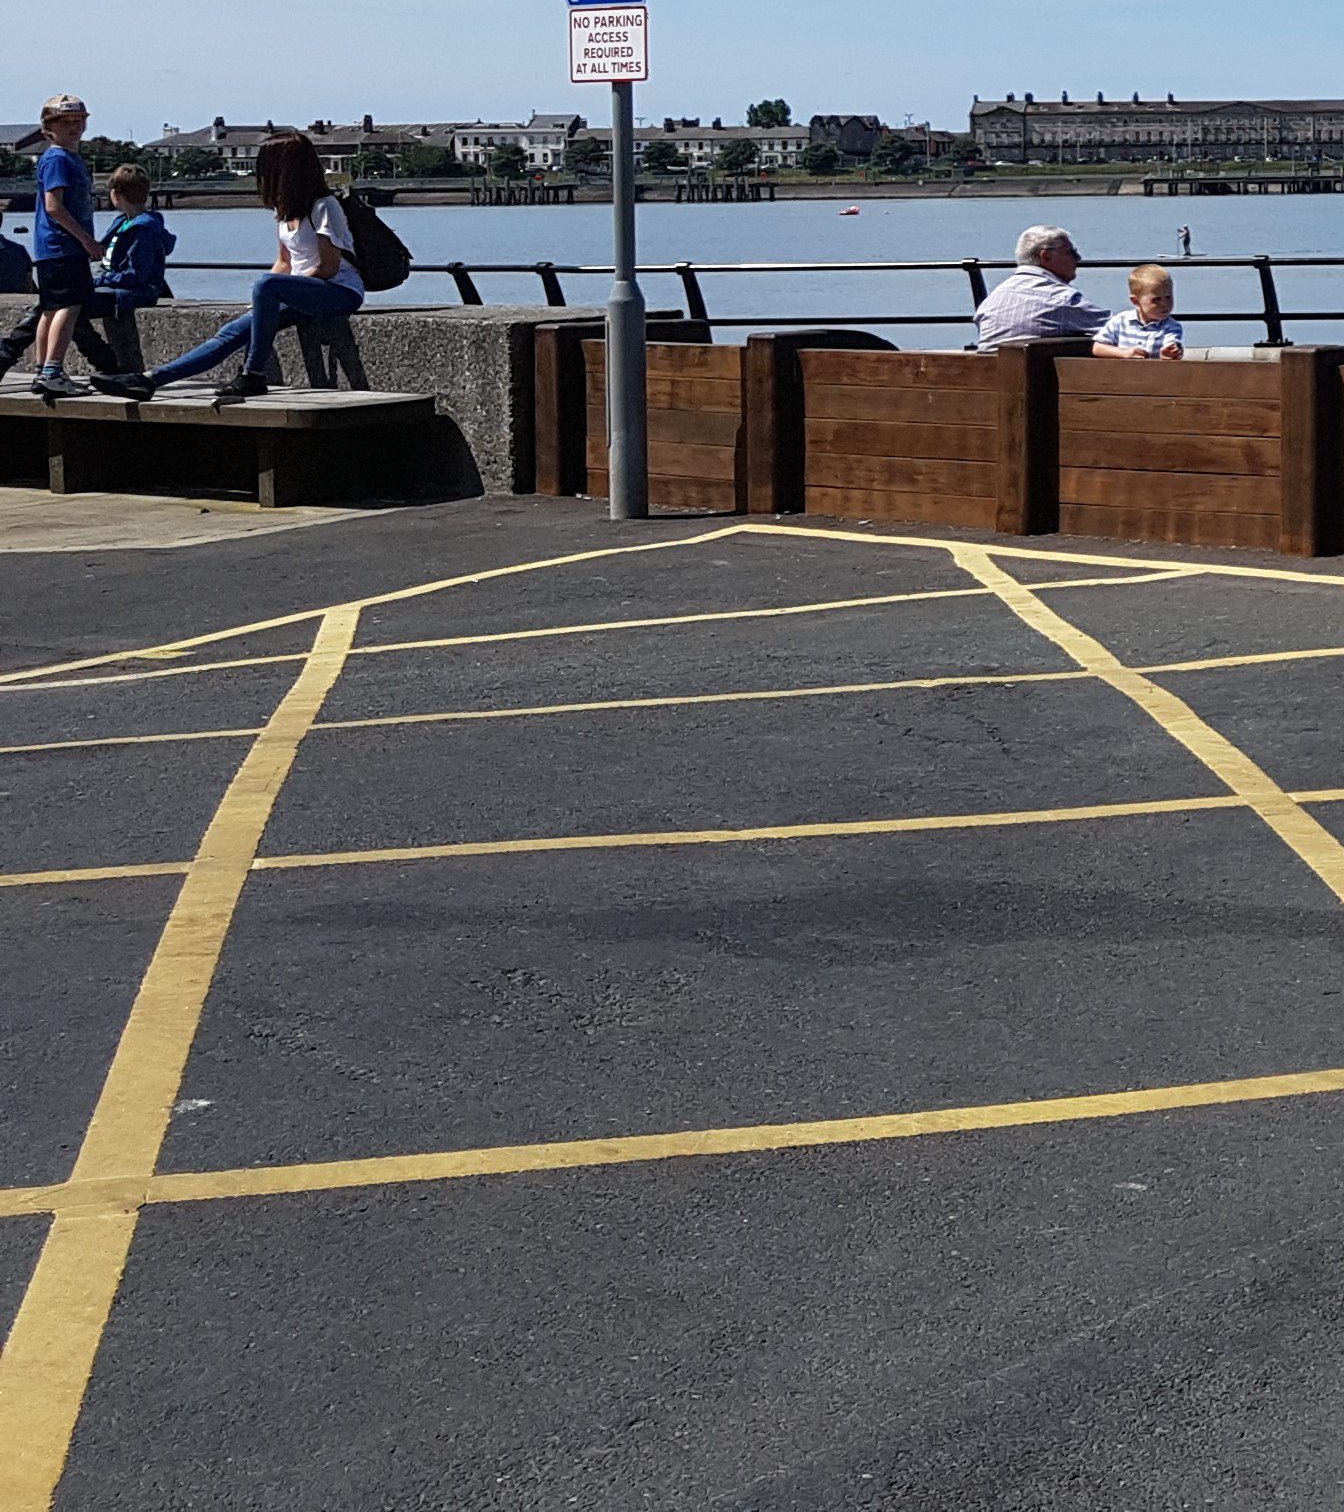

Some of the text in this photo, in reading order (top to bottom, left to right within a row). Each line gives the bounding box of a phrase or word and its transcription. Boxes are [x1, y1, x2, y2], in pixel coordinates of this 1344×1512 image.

[573, 15, 643, 29] NO PARKING
[588, 31, 629, 43] ACCESS
[584, 46, 634, 59] REQUIRED
[576, 61, 642, 74] AT ALL TIMES
